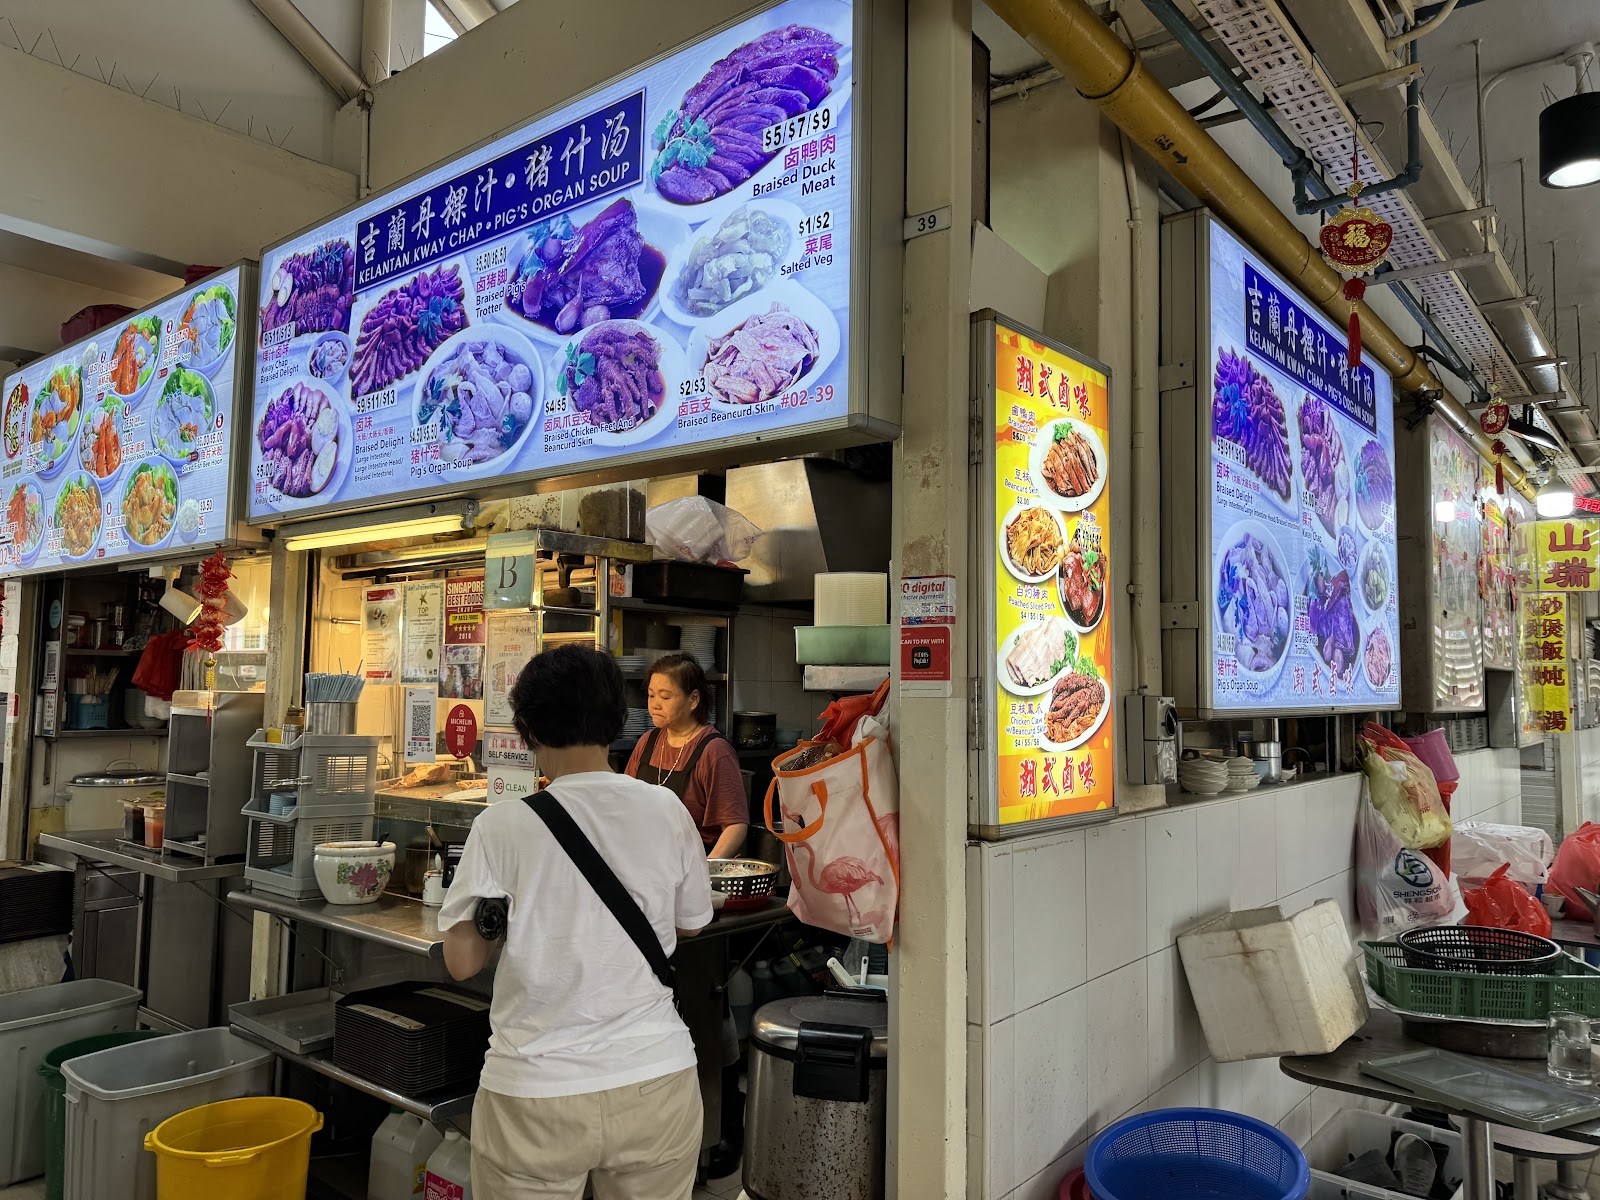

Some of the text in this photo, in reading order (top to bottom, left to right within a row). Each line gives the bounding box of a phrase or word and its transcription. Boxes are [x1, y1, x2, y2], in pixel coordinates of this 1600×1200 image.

[765, 108, 831, 149] $5/$7/$9
[784, 134, 836, 171] 卤鸭肉
[753, 157, 836, 197] Braised Duck
[802, 174, 836, 196] Meat
[359, 162, 630, 284] KELANTAN KWAY CHAP PIG'S ORGAN SOUP
[799, 212, 830, 237] $1/$2
[918, 214, 937, 231] 39
[805, 233, 833, 256] 菜尾
[1343, 224, 1371, 248] 福
[781, 254, 833, 276] Salted Veg
[477, 268, 508, 293] 卤猪脚
[476, 287, 505, 306] Braised
[476, 303, 503, 318] Trotter
[260, 364, 299, 384] Braised Delight
[261, 359, 289, 375] Kway Chap
[1249, 327, 1375, 427] KELANTAN KWAY CHAP PIG'S ORGAN SOUP
[680, 377, 706, 396] $2/$3
[781, 385, 835, 408] #02-39
[357, 389, 396, 413] $9/$11/$13
[545, 398, 567, 413] $4/$5
[678, 397, 712, 417] 卤豆支
[356, 416, 373, 432] 卤味
[544, 410, 592, 432] 卤凤爪豆支
[678, 403, 775, 429] Braised Beancurd Skin
[544, 419, 634, 443] Braised Chicken Feet And
[355, 436, 404, 455] Braised Delight
[411, 444, 440, 465] 猪什汤
[544, 436, 593, 454] Beancurd Skin
[256, 462, 273, 478] $5.00
[410, 458, 473, 479] Pig's Organ Soup
[255, 494, 283, 506] Kway Chap
[1217, 481, 1235, 498] Braised
[1236, 488, 1253, 506] Delight
[1574, 495, 1600, 514] OPE
[1545, 523, 1597, 589] 山瑞
[498, 555, 518, 589] B
[447, 580, 485, 595] SINGAPORE
[912, 580, 945, 595] digital
[447, 593, 484, 606] BEST FOODS
[935, 605, 954, 613] NETS
[1008, 596, 1029, 609] Poached
[1030, 602, 1044, 610] Sliced
[1217, 679, 1259, 694] Pig's Organ Soup
[450, 718, 472, 726] MICHELIN
[1011, 716, 1030, 726] Chicken
[488, 750, 528, 761] SELF-SERVICE
[495, 782, 527, 792] SG CLEAN
